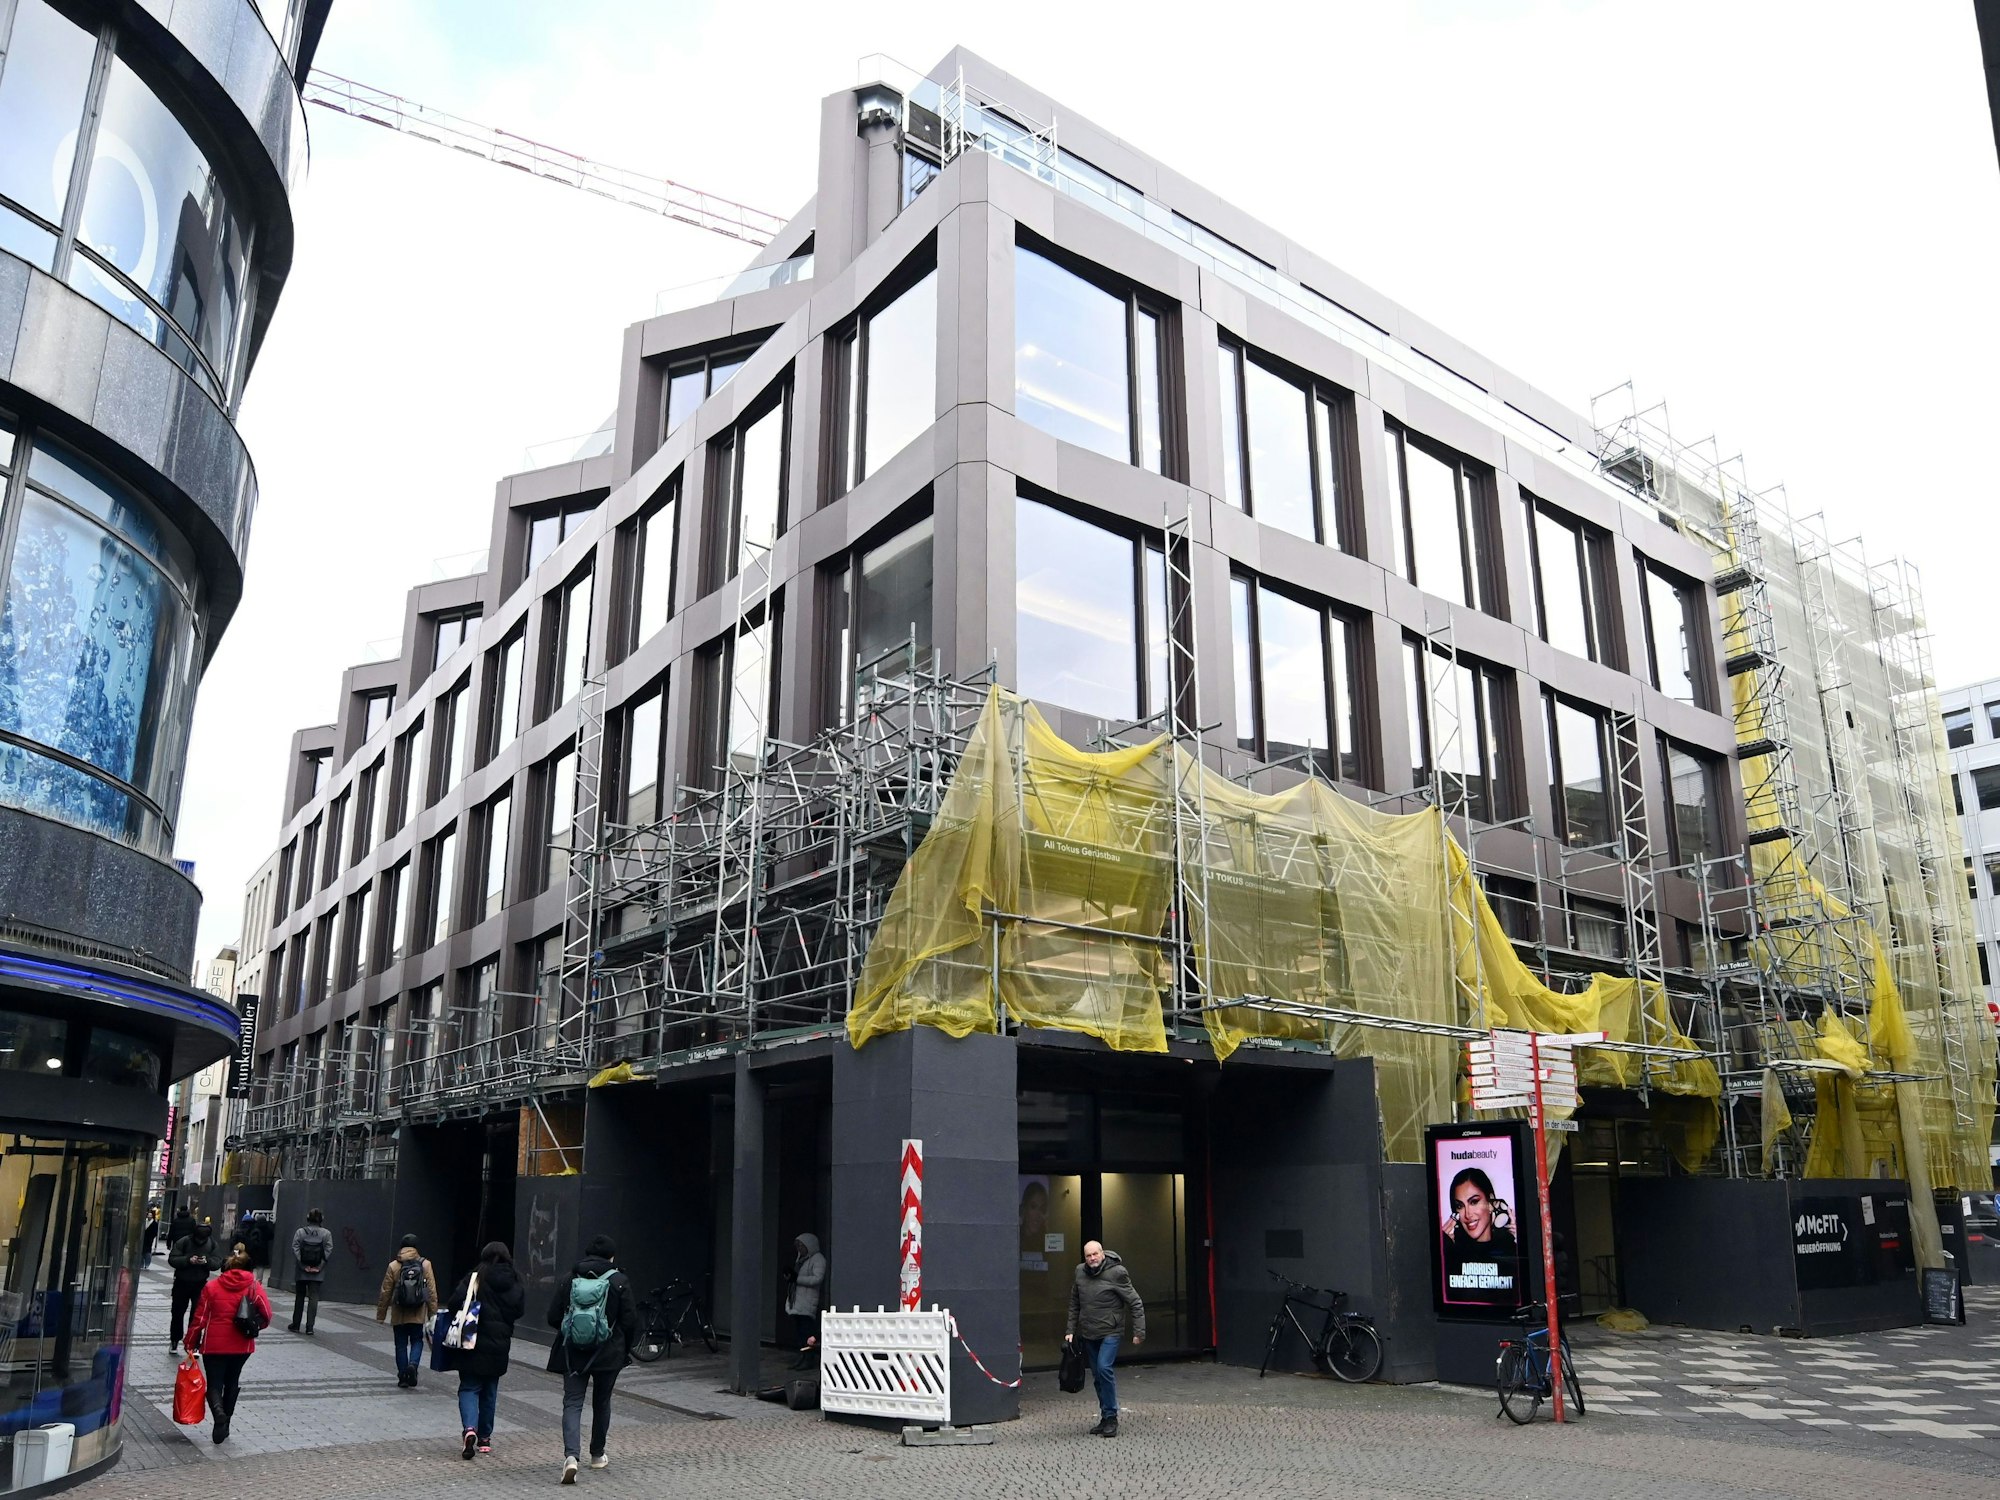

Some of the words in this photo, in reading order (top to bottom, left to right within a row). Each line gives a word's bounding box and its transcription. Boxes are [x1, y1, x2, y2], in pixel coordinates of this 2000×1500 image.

[1044, 839, 1055, 850] Ali
[1057, 842, 1080, 855] Tokus
[1081, 846, 1121, 862] Gerüstbau
[1216, 873, 1244, 886] TOKUS
[1729, 961, 1749, 969] Tokus
[930, 1003, 942, 1014] Ali
[944, 1005, 972, 1018] Tokus
[233, 1002, 258, 1091] hunkemöller
[1249, 1036, 1283, 1047] Gerüstbau
[1732, 1080, 1742, 1088] Ali
[1743, 1079, 1763, 1087] Tokus
[1481, 1099, 1519, 1107] Hauptbahnhof
[1551, 1120, 1560, 1128] der
[160, 1143, 171, 1175] TALLY
[1450, 1149, 1498, 1161] hudabeauty
[1806, 1214, 1839, 1235] McFIT
[1796, 1240, 1842, 1254] NEUERÖFFNUNG
[1461, 1262, 1498, 1277] AIRBRUSH
[1449, 1274, 1479, 1289] EINFACH
[1478, 1275, 1513, 1290] GEMACHT
